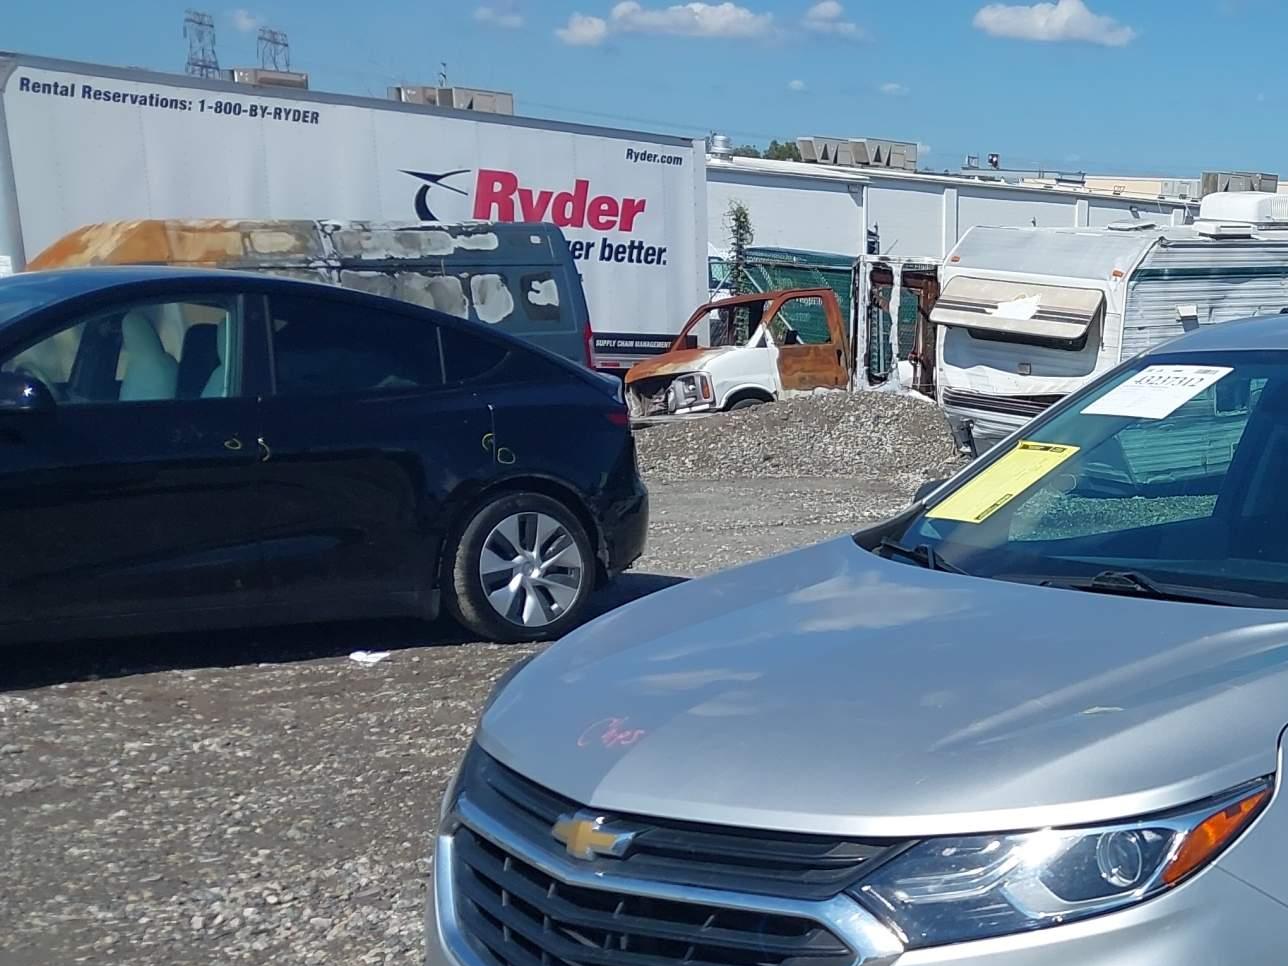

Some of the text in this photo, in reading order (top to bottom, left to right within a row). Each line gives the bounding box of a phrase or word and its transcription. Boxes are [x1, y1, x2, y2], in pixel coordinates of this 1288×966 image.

[18, 76, 321, 125] Rental Reservations: 1-800-BY-RYDER
[625, 148, 684, 166] Ryder.com
[472, 168, 647, 232] Ryder
[598, 237, 668, 266] better.
[595, 339, 672, 349] SUPPLY CHAIN MANAGEMENT
[1133, 374, 1205, 388] 43237312
